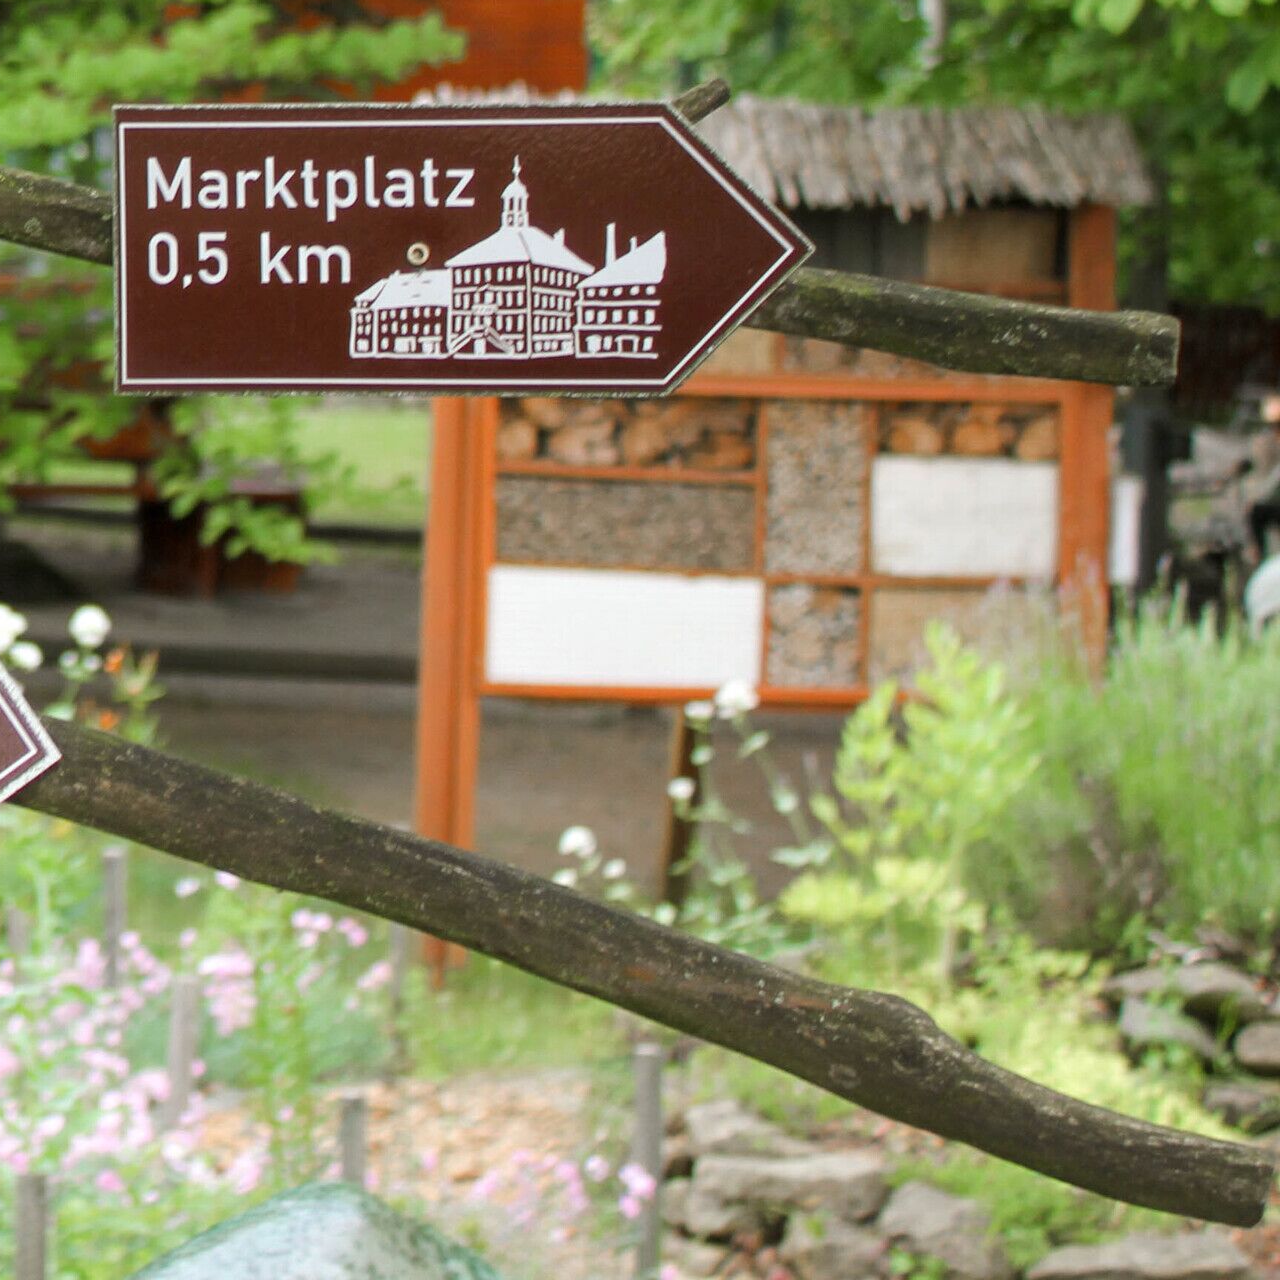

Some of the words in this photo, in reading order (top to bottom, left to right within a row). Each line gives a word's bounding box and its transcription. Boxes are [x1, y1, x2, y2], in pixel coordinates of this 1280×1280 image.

[147, 155, 475, 223] Marktplatz
[148, 231, 228, 289] 0,5
[260, 231, 351, 284] km
